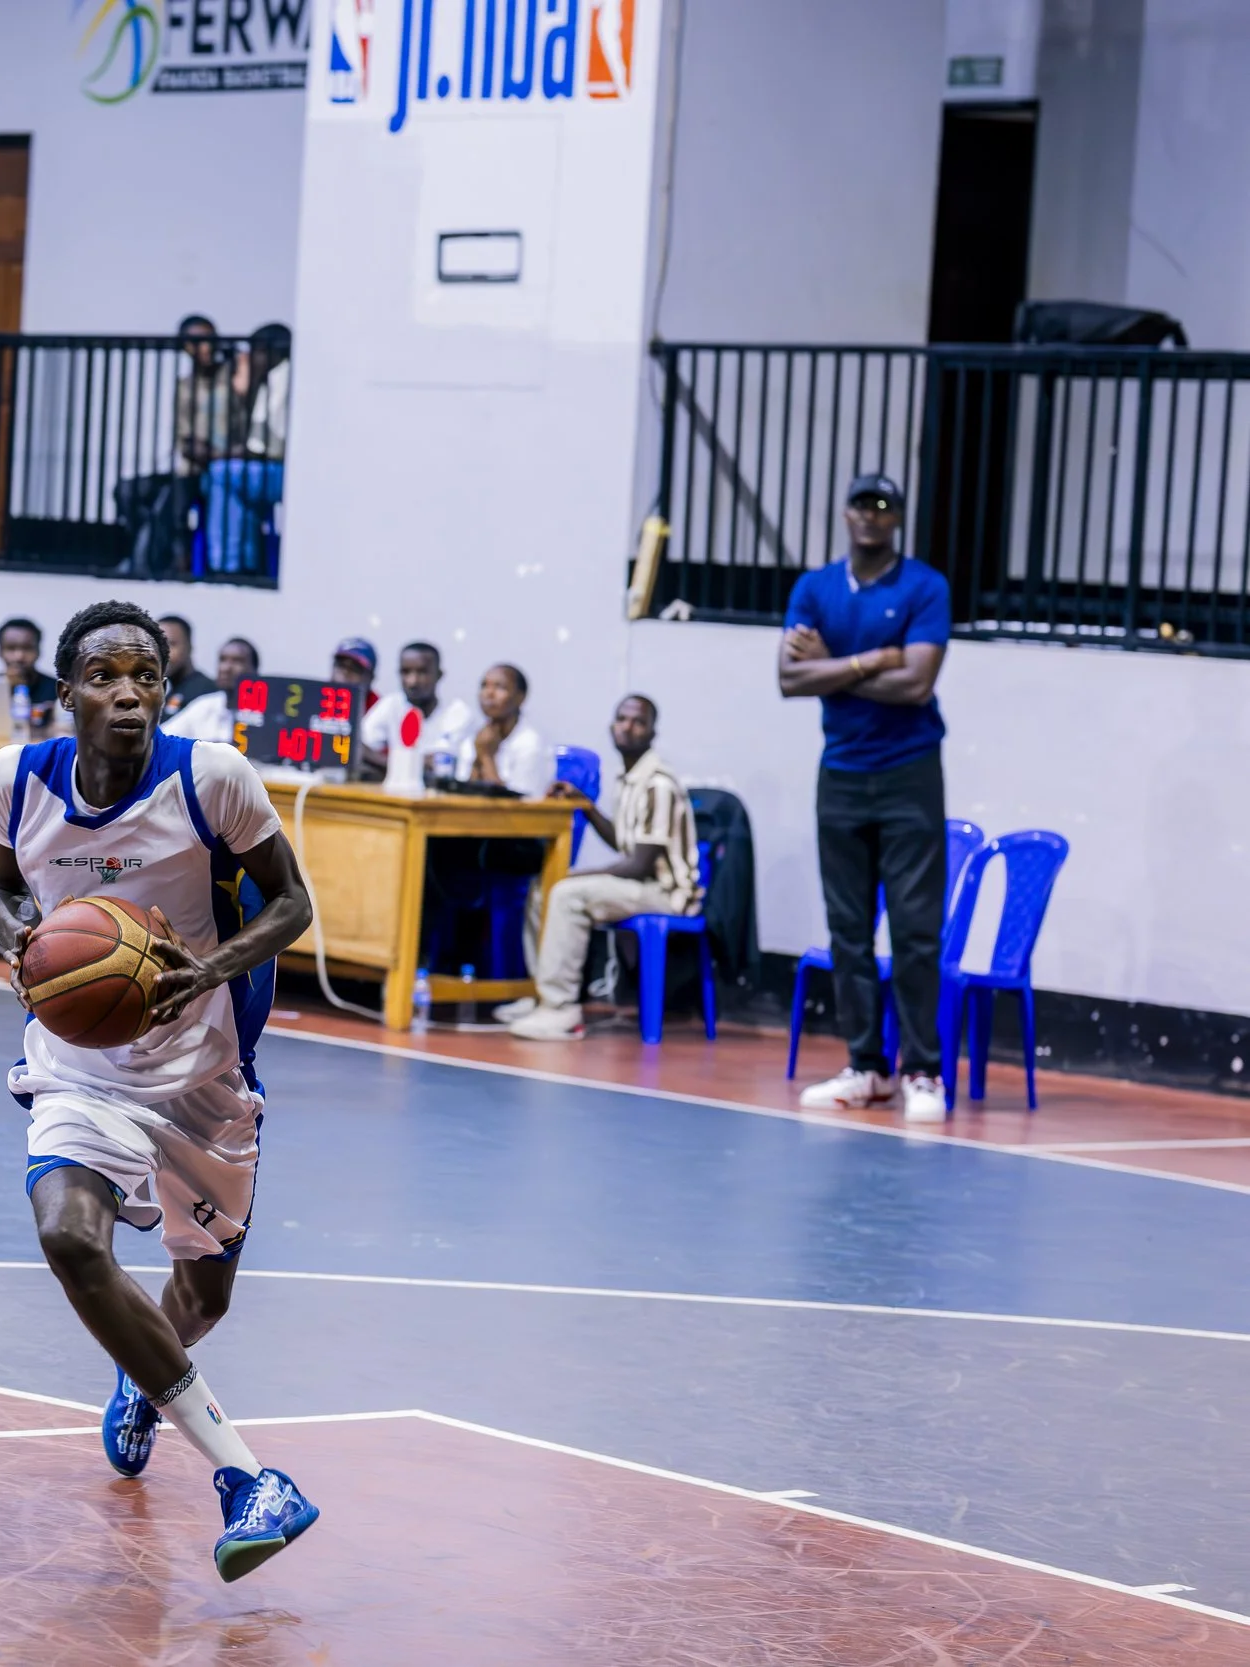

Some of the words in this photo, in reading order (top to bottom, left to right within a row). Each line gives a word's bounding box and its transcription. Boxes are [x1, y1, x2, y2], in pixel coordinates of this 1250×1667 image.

[164, 0, 309, 53] FERW
[285, 684, 303, 717] 2
[319, 687, 352, 720] 33
[333, 735, 350, 764] 4
